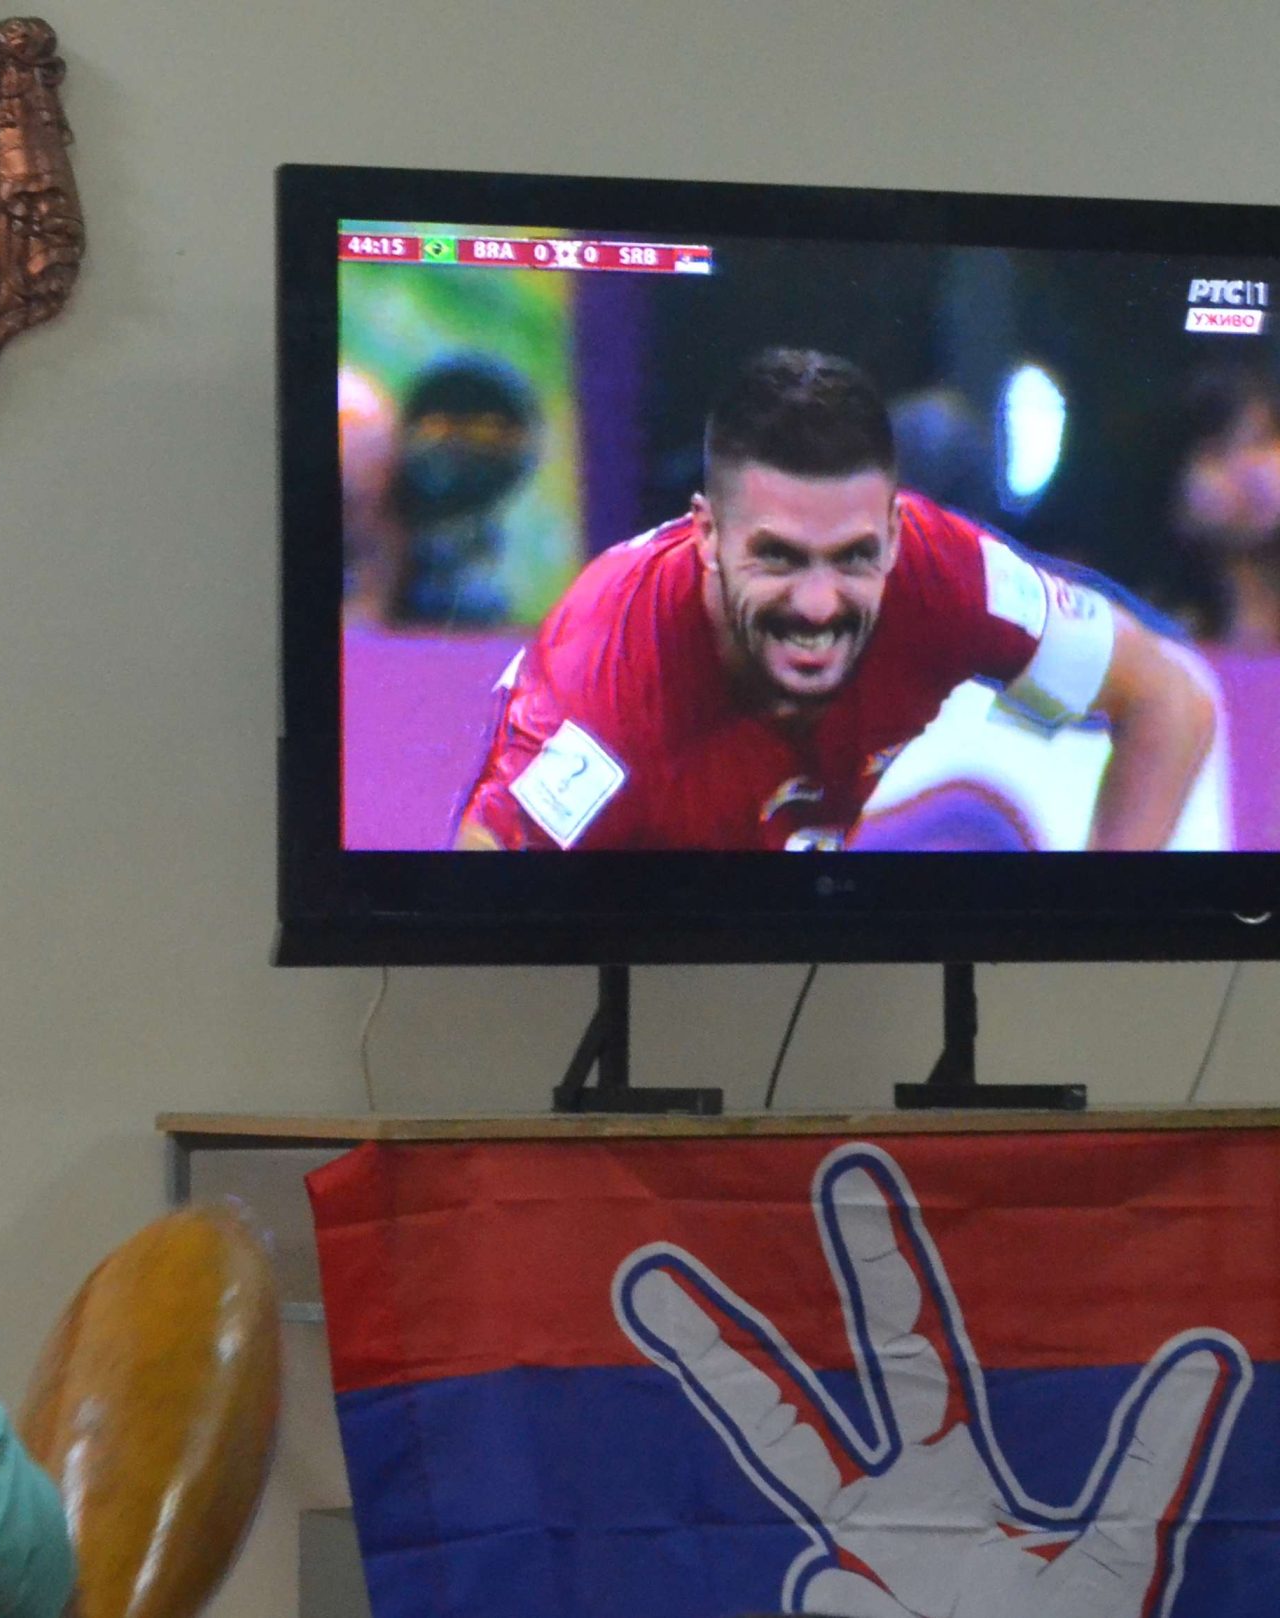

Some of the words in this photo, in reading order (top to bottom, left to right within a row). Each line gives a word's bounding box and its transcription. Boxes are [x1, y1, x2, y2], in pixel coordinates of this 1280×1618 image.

[348, 237, 404, 255] 44:15
[473, 241, 515, 260] BRA
[534, 244, 548, 261] 0
[583, 246, 597, 263] 0
[619, 247, 657, 265] SRB
[1192, 312, 1255, 328] УЖИВО
